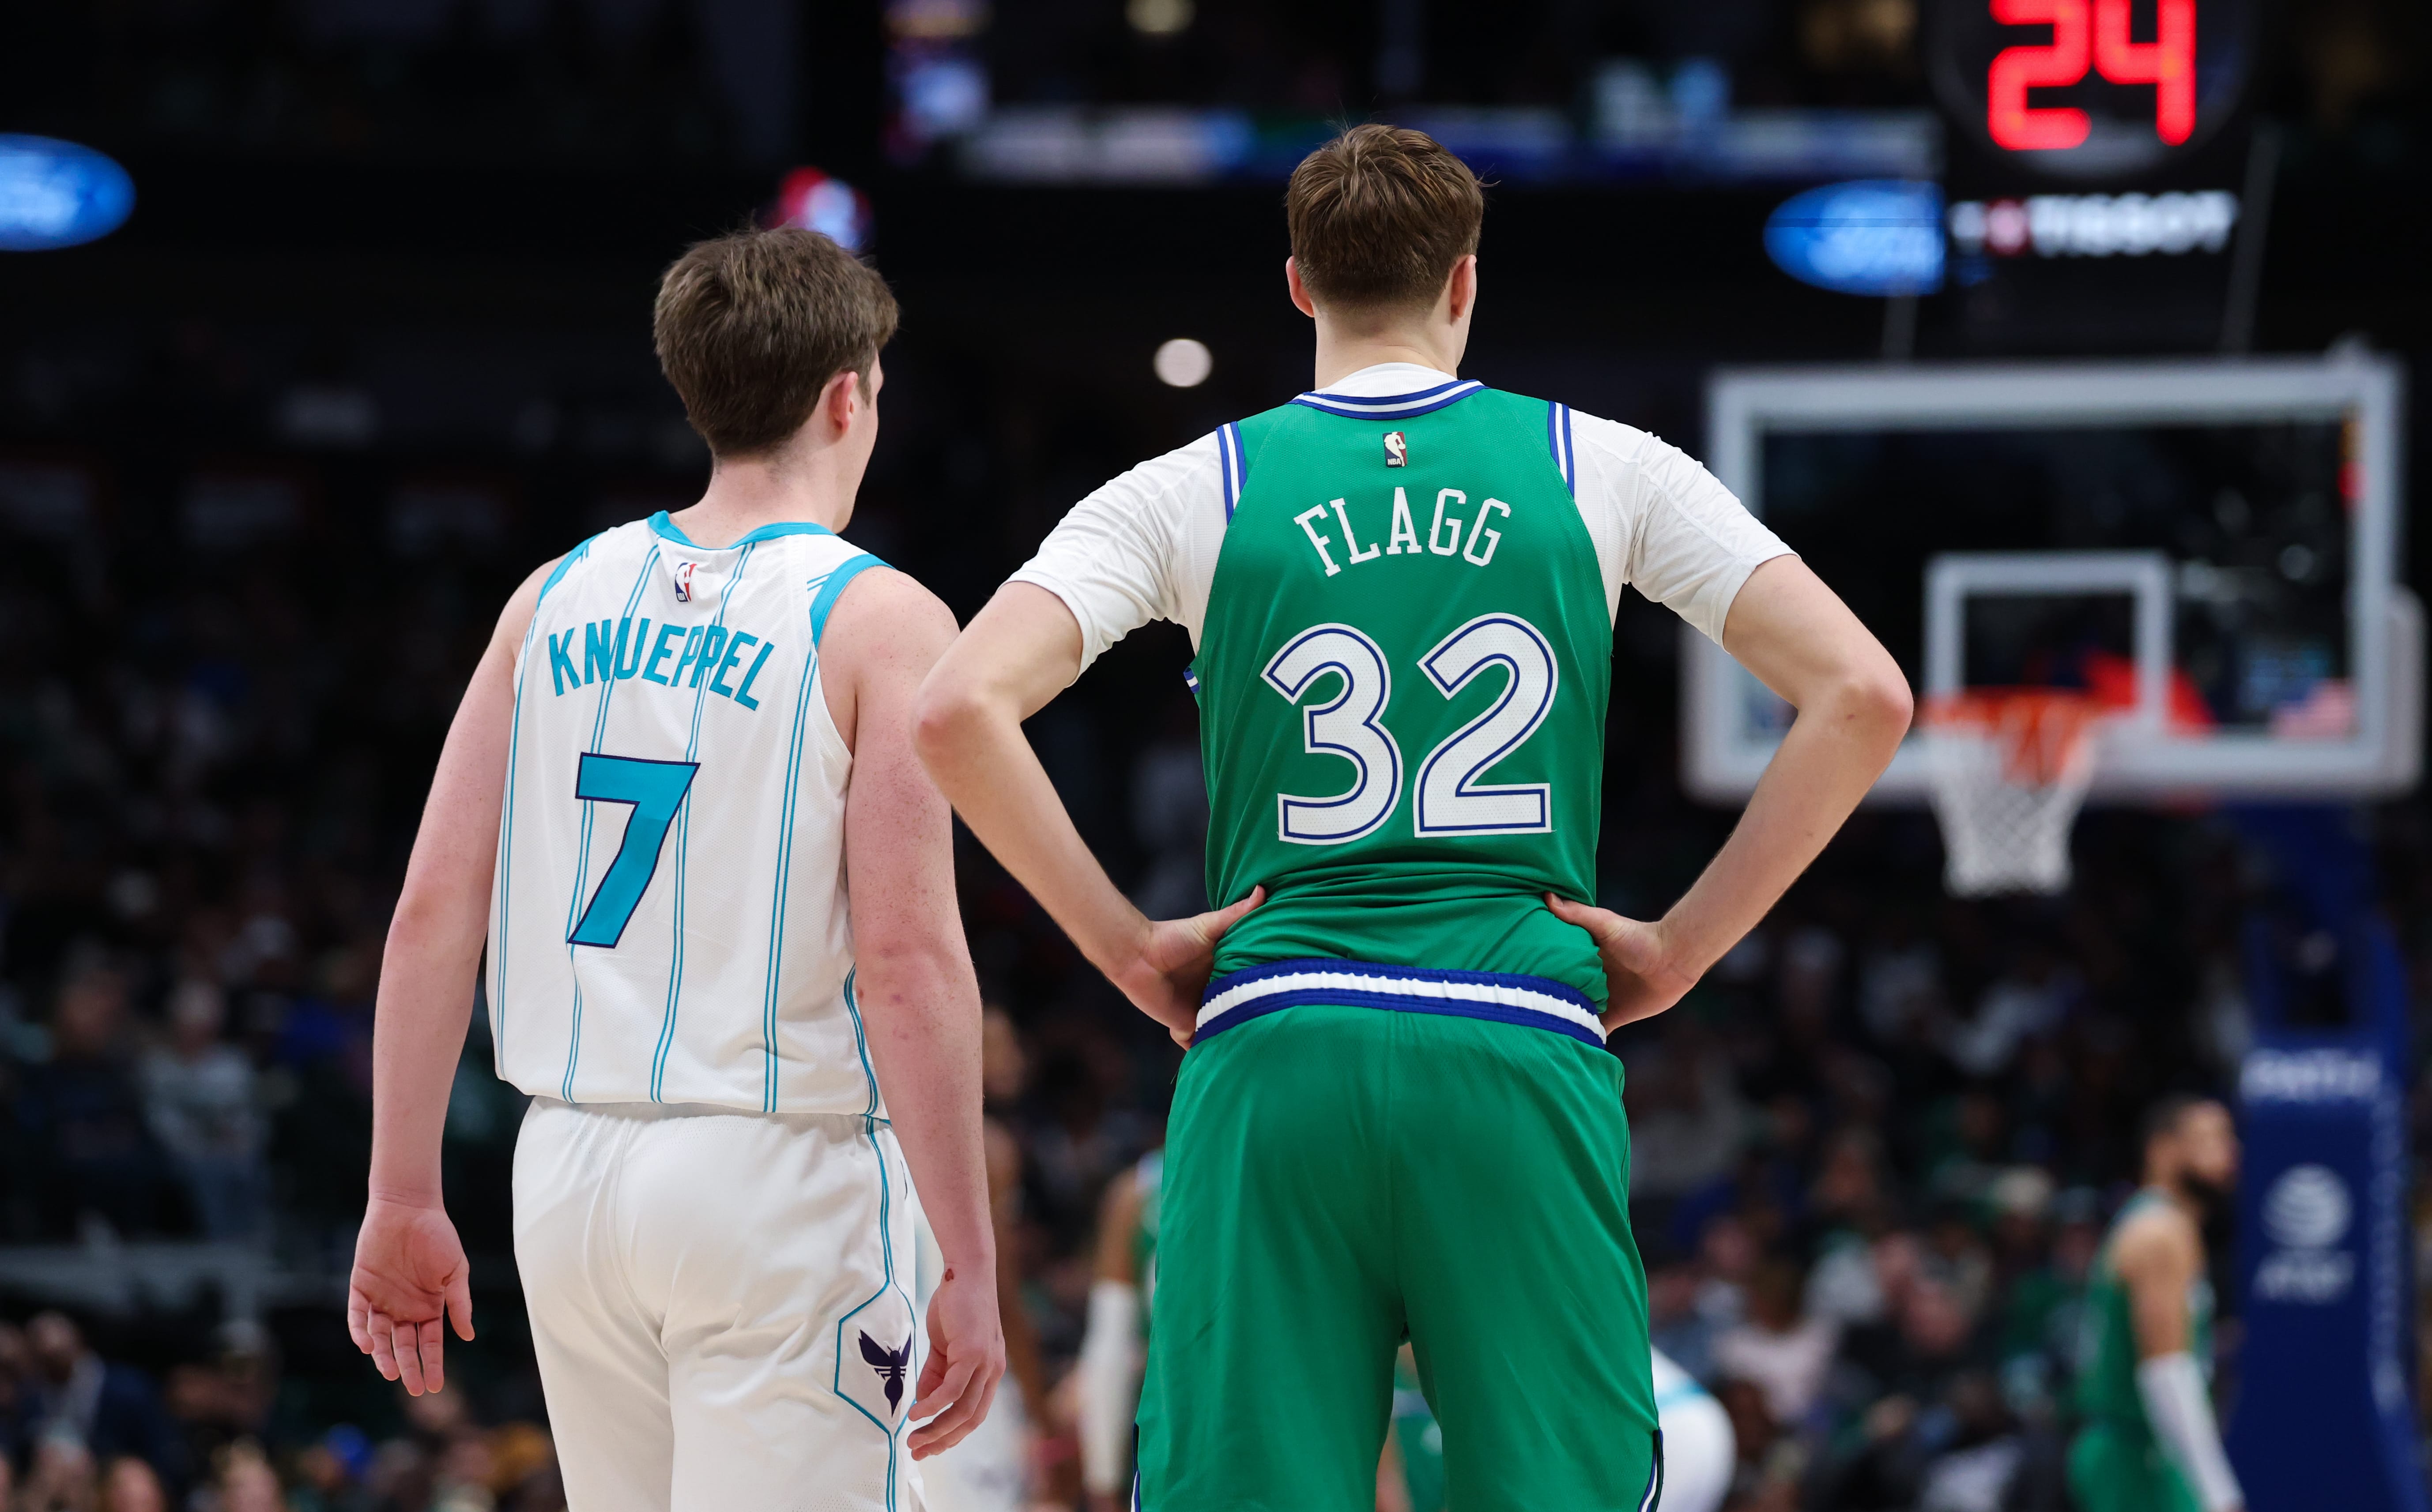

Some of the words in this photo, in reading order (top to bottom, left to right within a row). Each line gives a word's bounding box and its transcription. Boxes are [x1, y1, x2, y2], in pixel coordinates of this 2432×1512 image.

[1988, 0, 2196, 151] 24
[1293, 487, 1511, 577] FLAGG
[548, 617, 775, 711] KNUEPPEL
[1260, 613, 1559, 846] 32
[567, 752, 700, 949] 7
